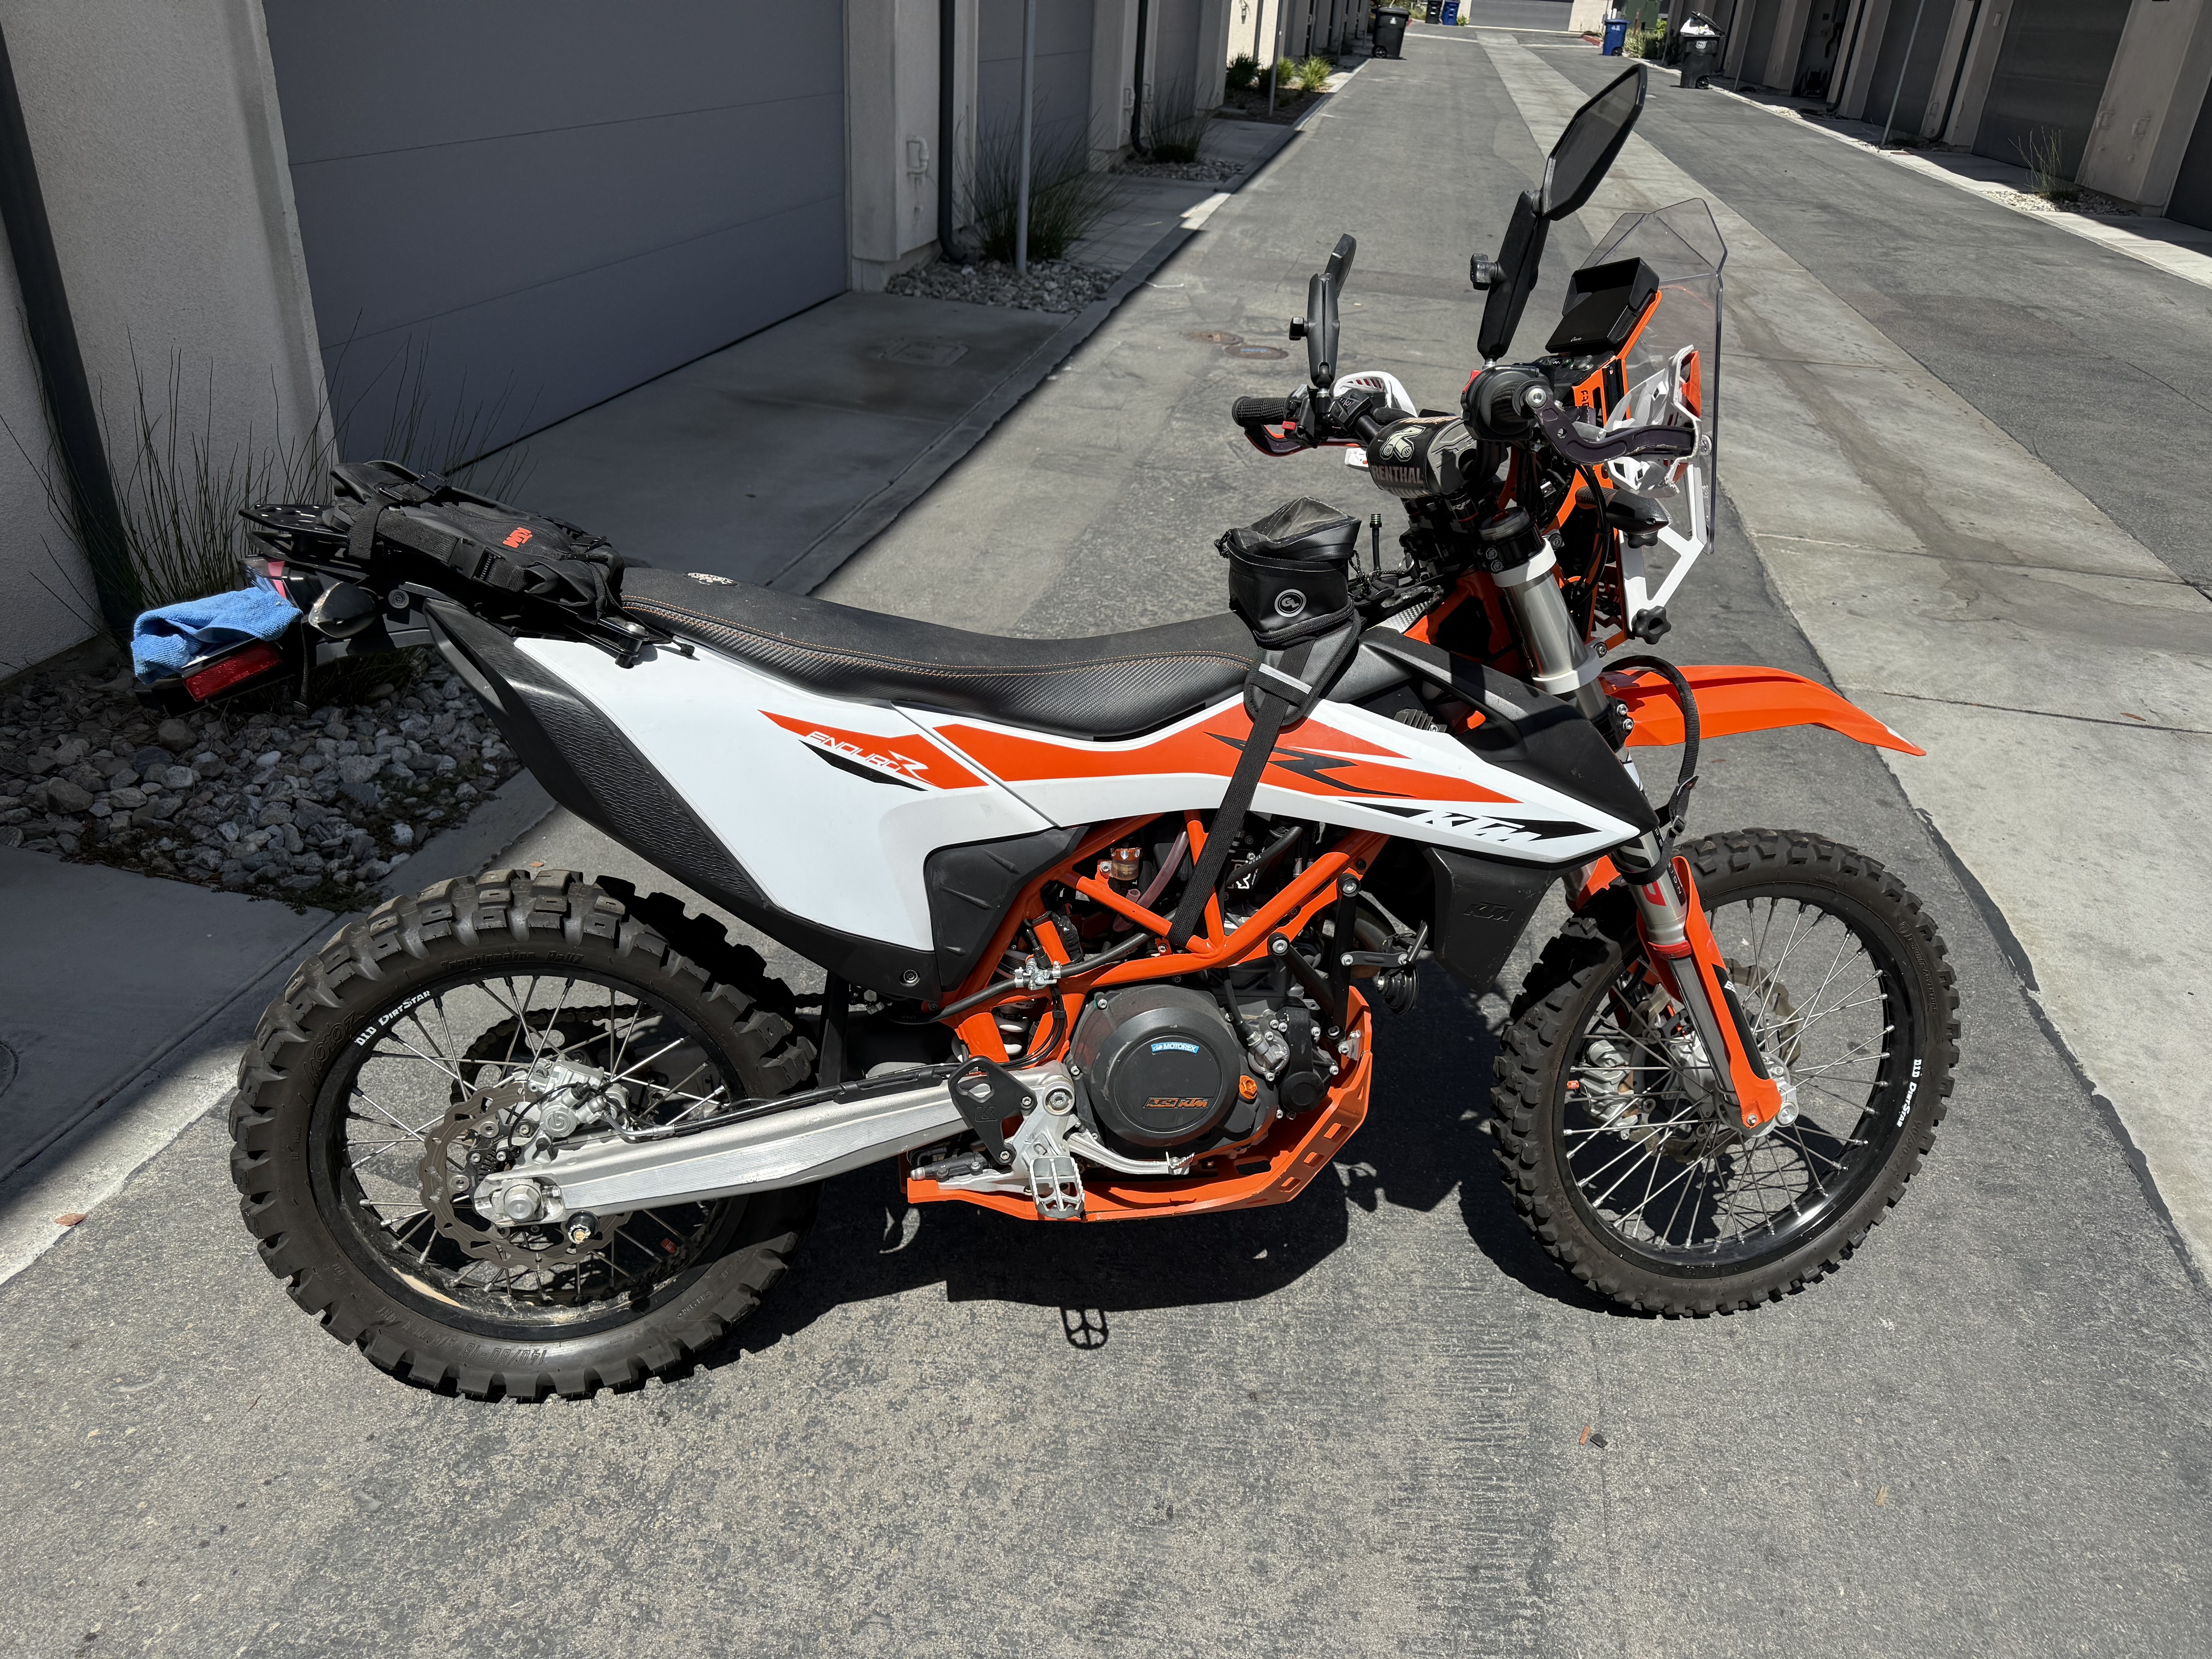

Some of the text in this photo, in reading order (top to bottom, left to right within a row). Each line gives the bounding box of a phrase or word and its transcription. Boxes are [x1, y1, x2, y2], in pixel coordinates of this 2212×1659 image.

[1371, 465, 1423, 484] RENTHAL
[502, 527, 533, 548] KTM
[805, 731, 902, 772] ENDURO
[1423, 811, 1542, 842] KTM
[1463, 902, 1514, 921] KTM
[1164, 1043, 1196, 1052] MOTOREX
[1178, 1097, 1208, 1108] KTM
[460, 1344, 546, 1365] 140/80-18
